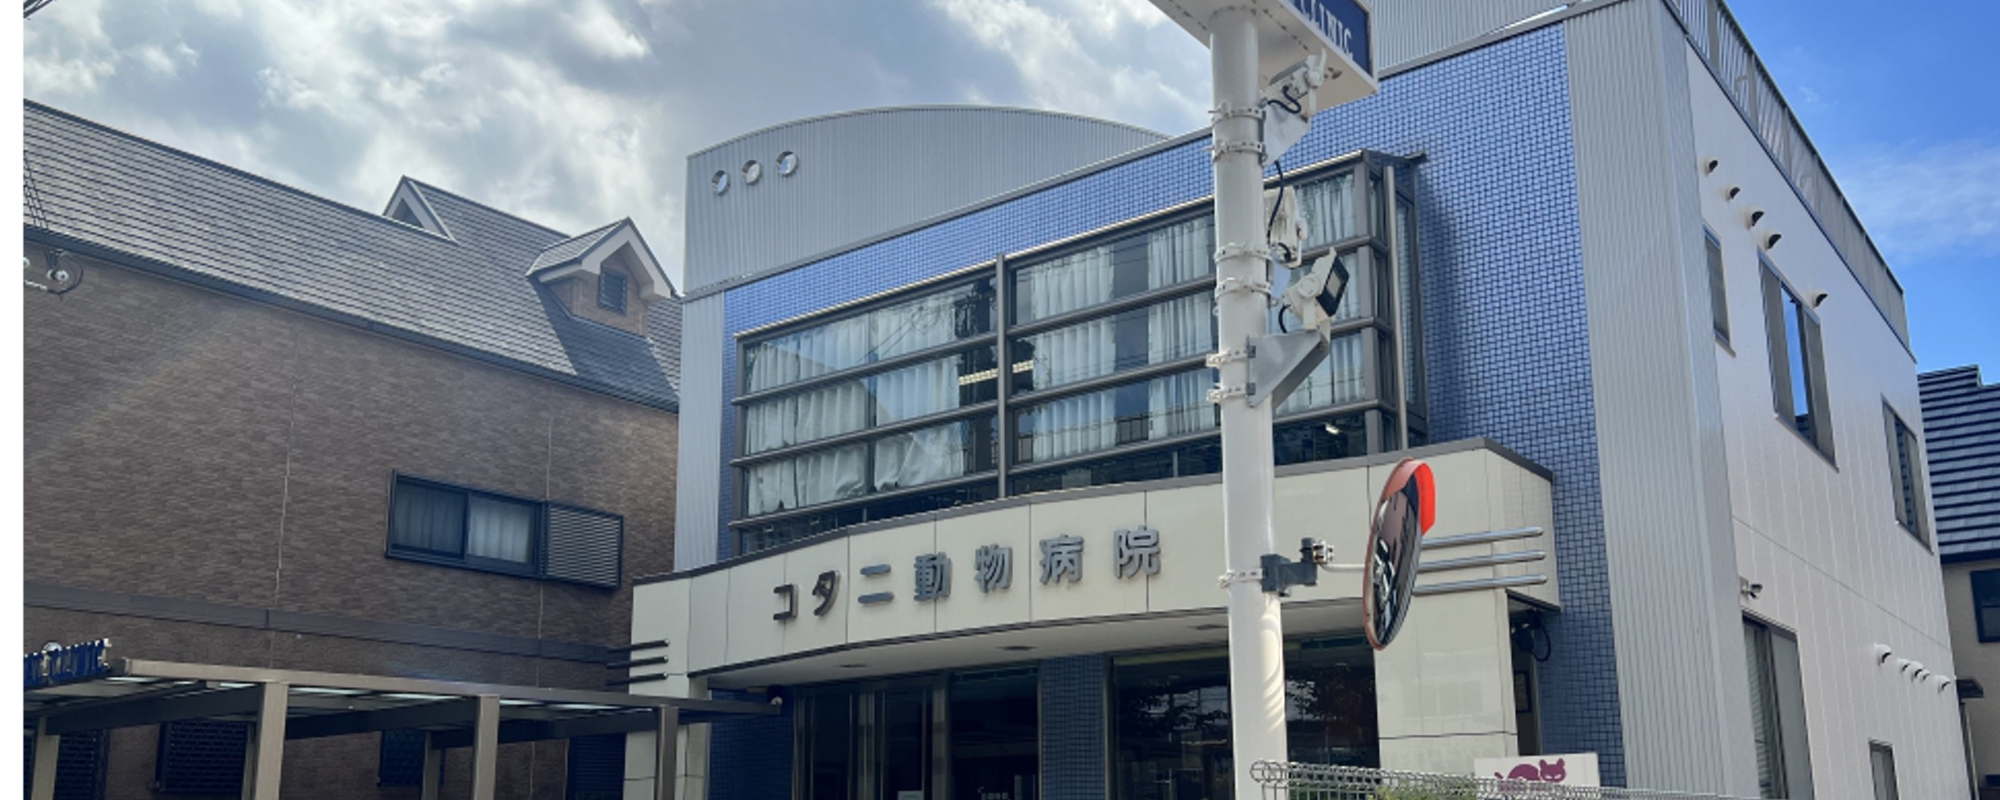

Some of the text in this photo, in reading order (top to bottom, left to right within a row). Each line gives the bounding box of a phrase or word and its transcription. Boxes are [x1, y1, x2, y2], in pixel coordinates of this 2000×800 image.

[773, 525, 1161, 621] コタニ動物病院
